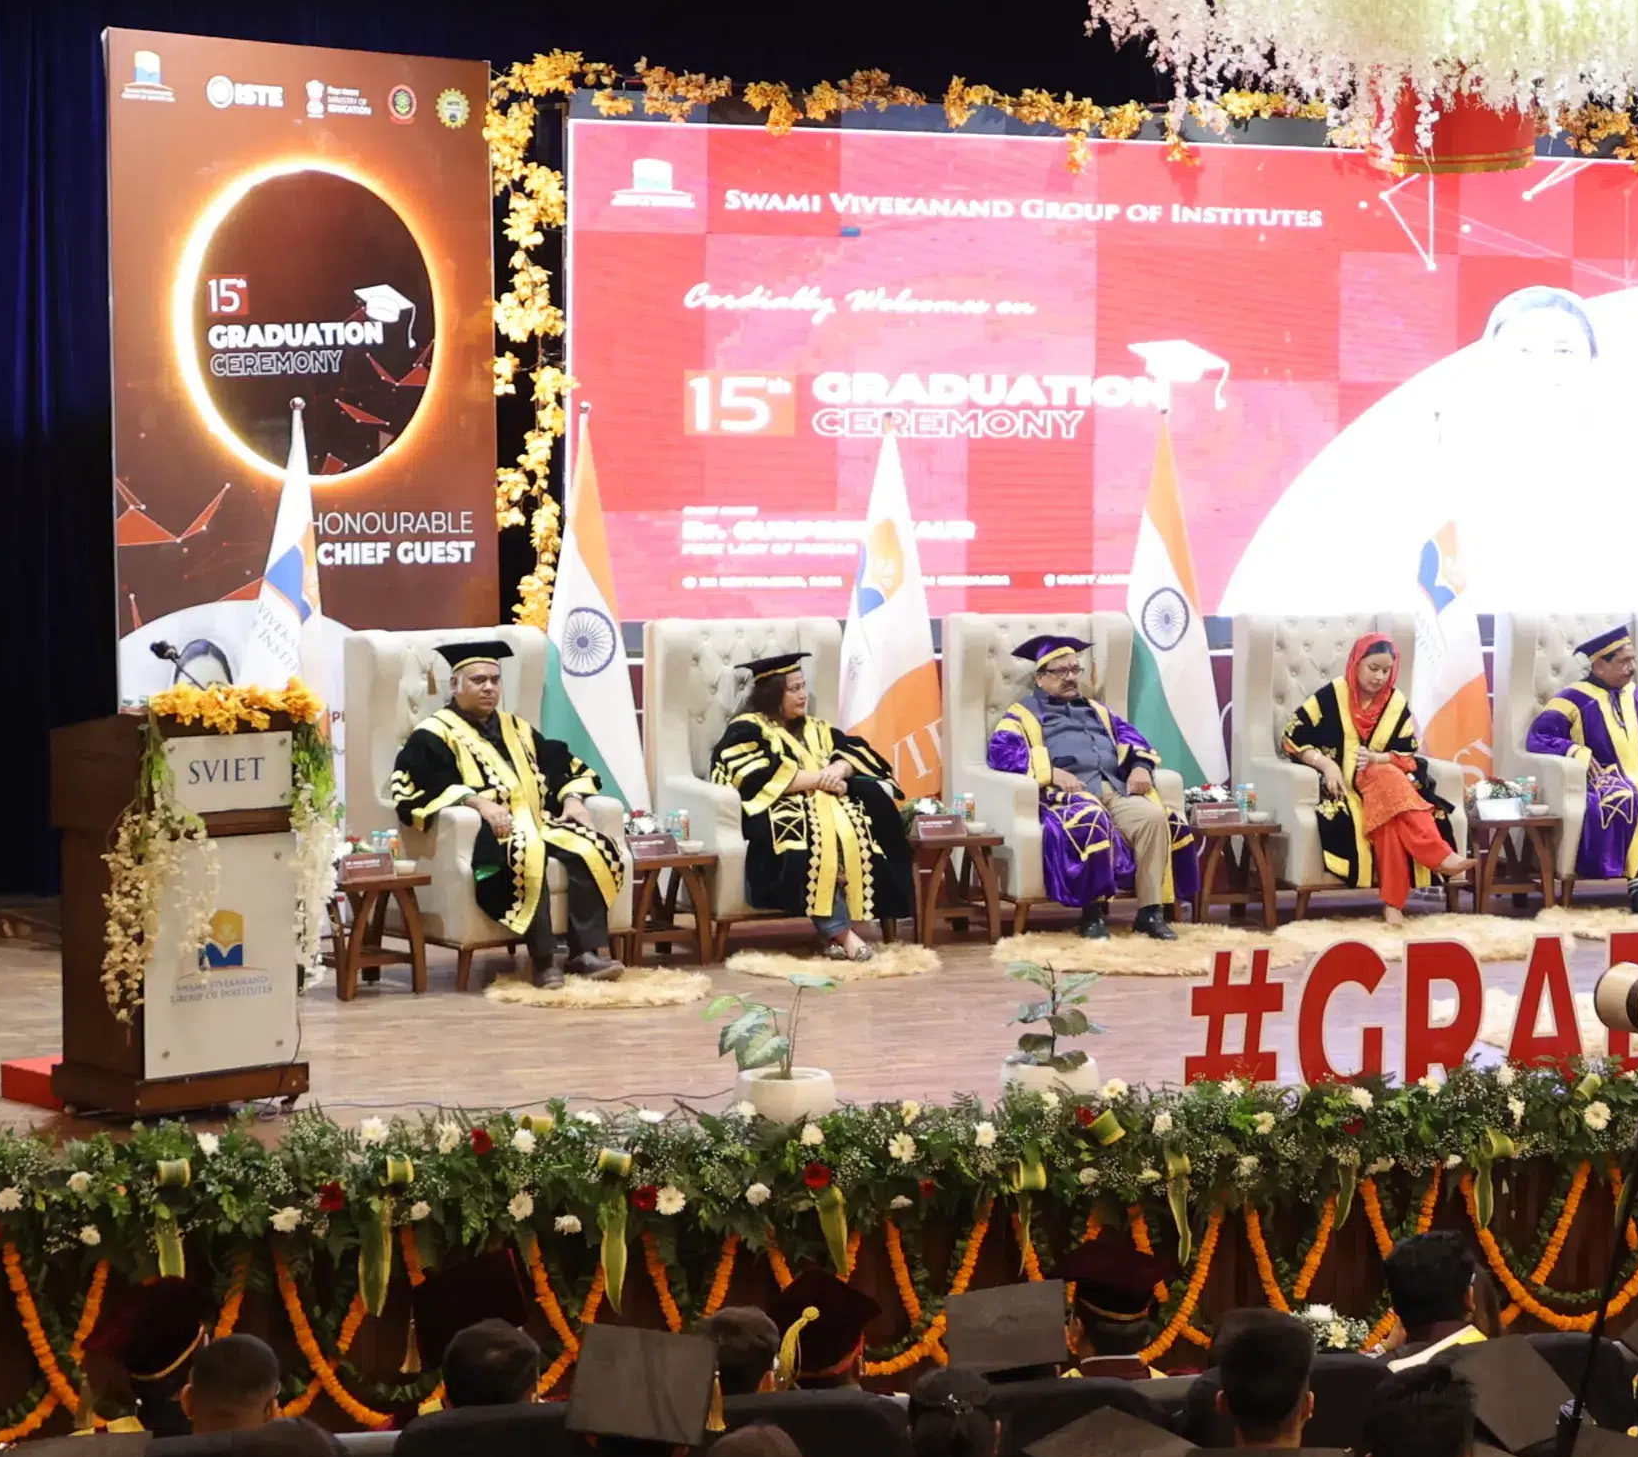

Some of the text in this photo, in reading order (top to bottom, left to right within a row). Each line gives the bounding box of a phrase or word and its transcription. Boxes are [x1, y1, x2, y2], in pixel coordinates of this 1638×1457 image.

[830, 192, 1014, 219] VIVEKANAND
[1020, 198, 1120, 221] GROUP
[1126, 204, 1162, 222] OF
[1171, 203, 1323, 228] INSTITUTES
[683, 282, 836, 326] Cordially
[207, 320, 384, 350] GRADUATION
[210, 349, 343, 377] CEREMONY
[811, 372, 1170, 408] GRADUATION
[811, 408, 1085, 440] CEREMONY
[317, 540, 476, 566] CHIEF GUEST
[188, 756, 266, 785] SVIET
